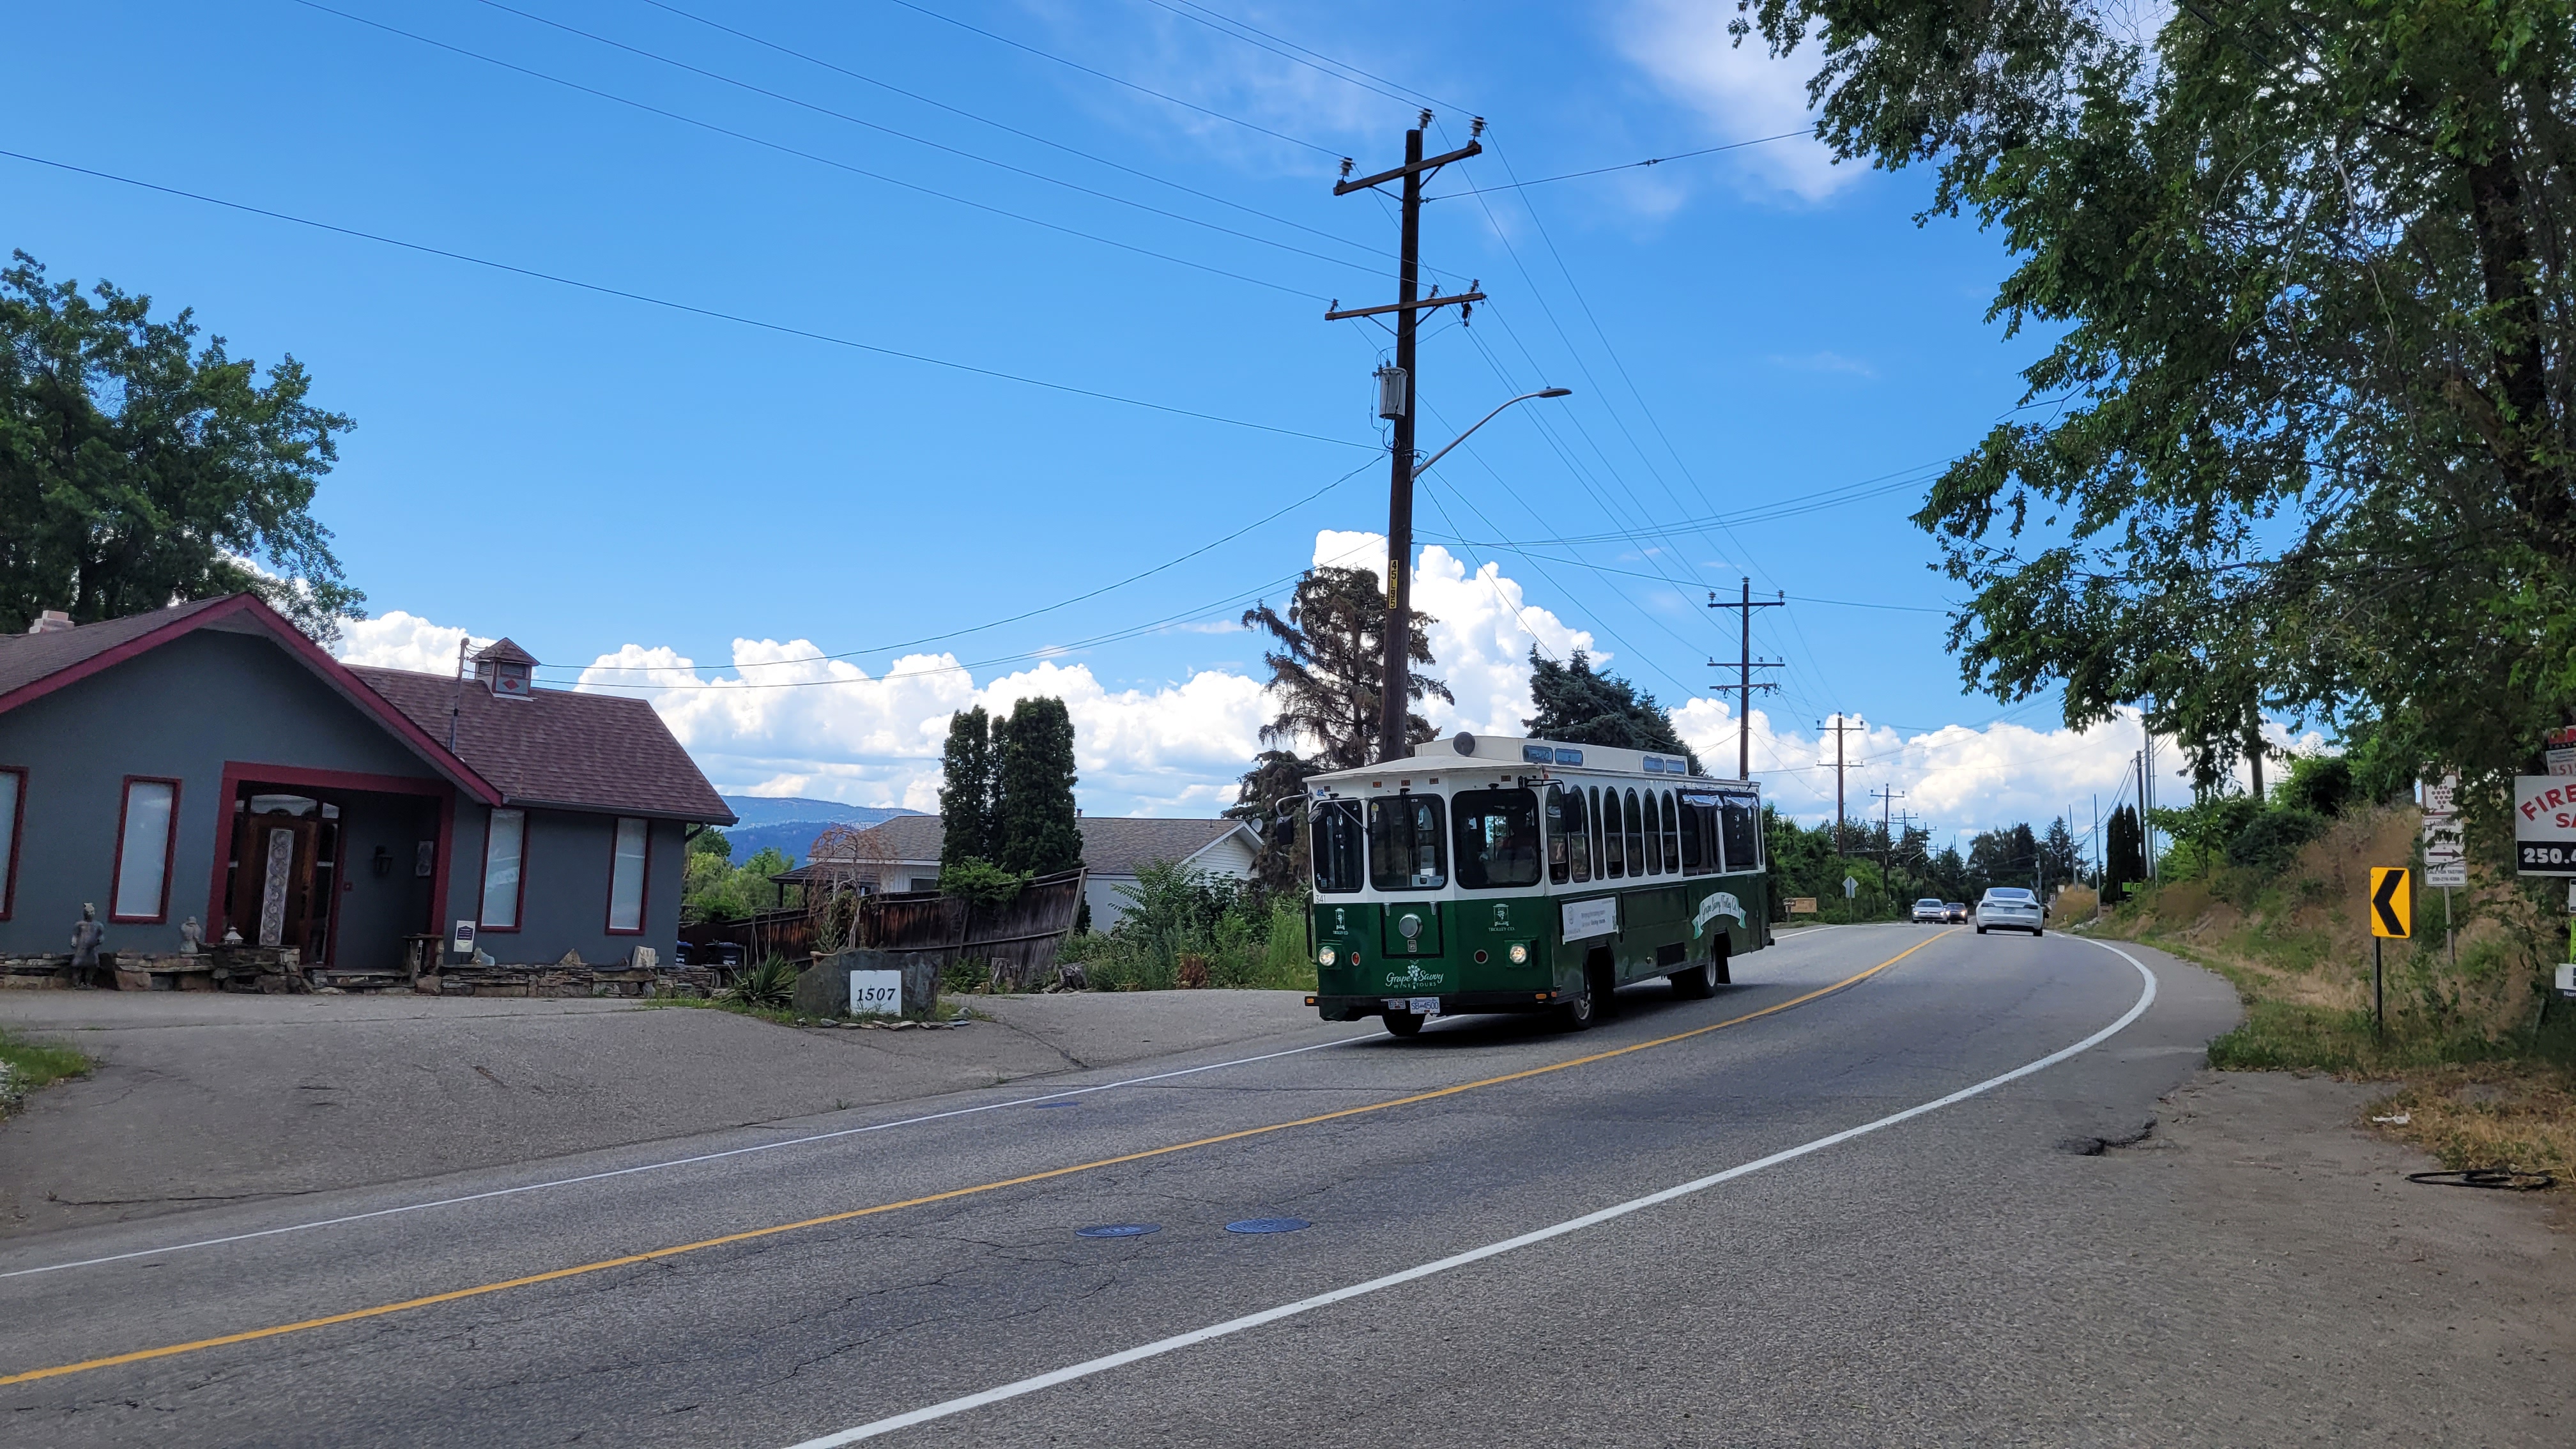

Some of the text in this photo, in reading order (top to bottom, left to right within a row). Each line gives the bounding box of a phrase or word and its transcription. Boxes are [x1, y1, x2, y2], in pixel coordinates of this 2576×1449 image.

[1385, 970, 1444, 987] Grape Savvy
[857, 988, 896, 1001] 1507
